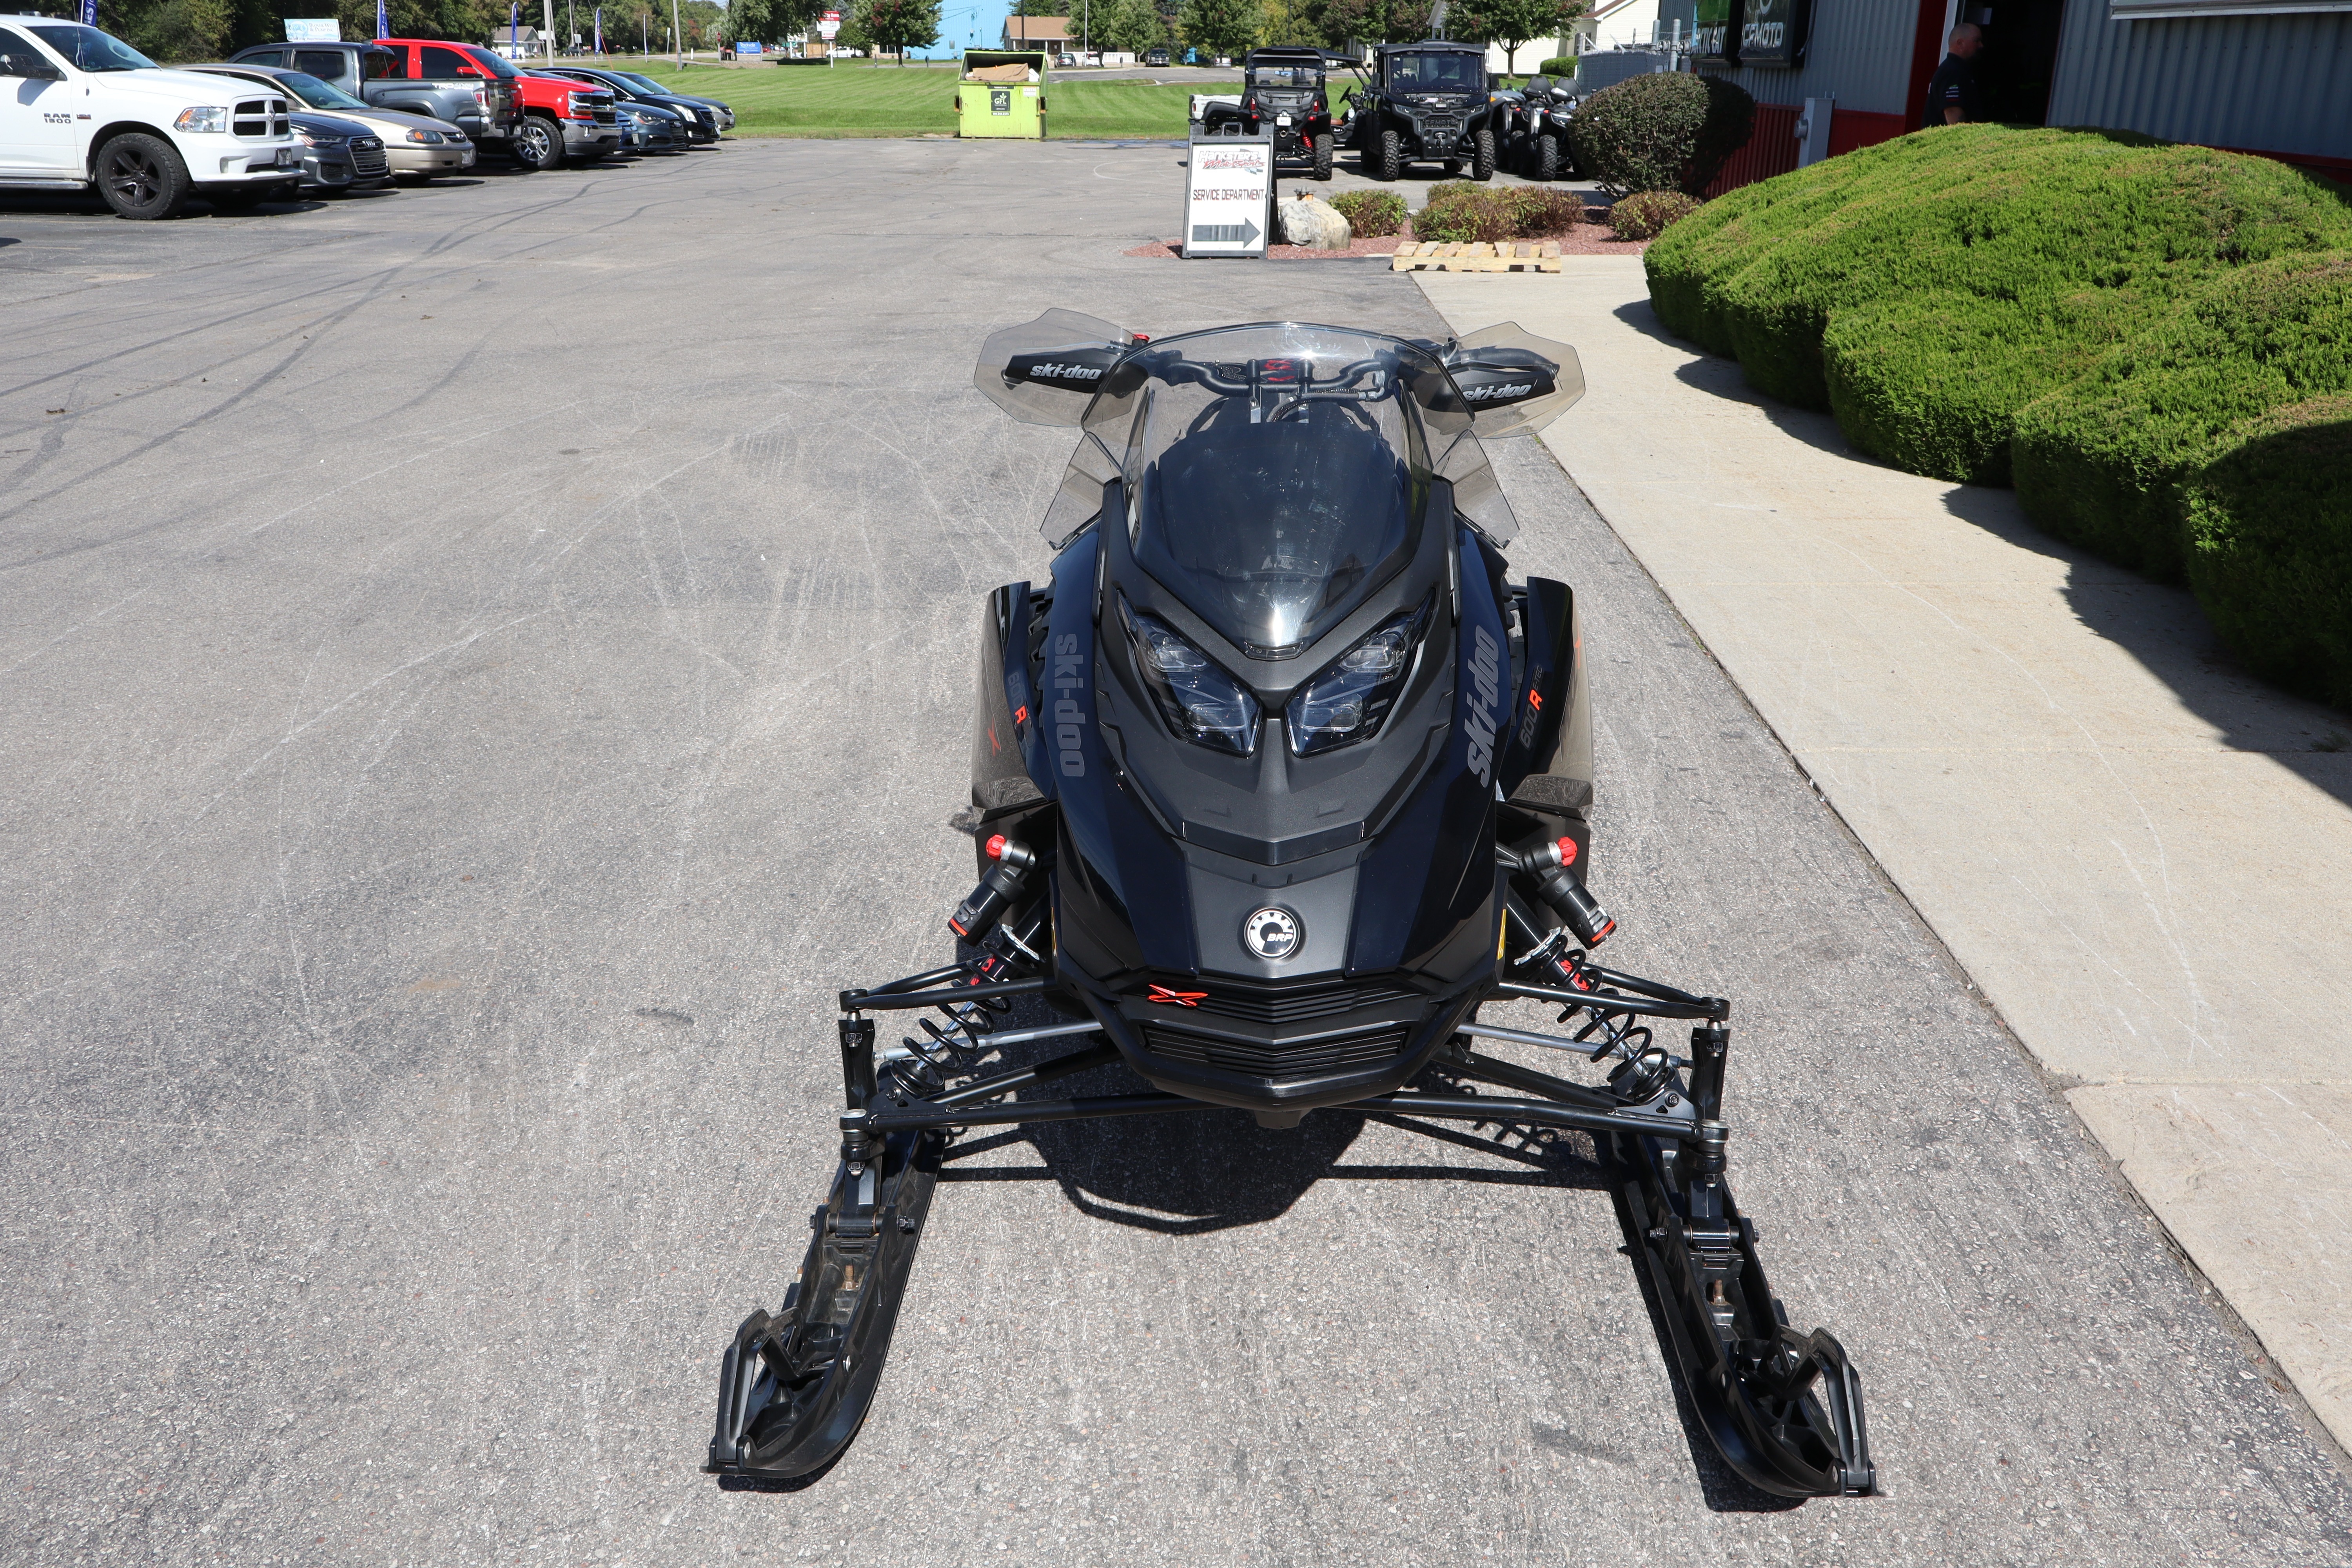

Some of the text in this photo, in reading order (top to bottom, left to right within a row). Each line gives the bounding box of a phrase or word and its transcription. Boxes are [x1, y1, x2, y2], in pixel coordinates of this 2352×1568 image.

[1193, 189, 1264, 201] SERVICE DEPARTMENT
[1030, 363, 1102, 380] ski-doo
[1463, 383, 1532, 401] ski-doo
[1532, 665, 1543, 691] E-TEC
[1054, 633, 1086, 777] ski-doo
[1465, 625, 1499, 788] ski-doo
[1267, 933, 1294, 942] BRP
